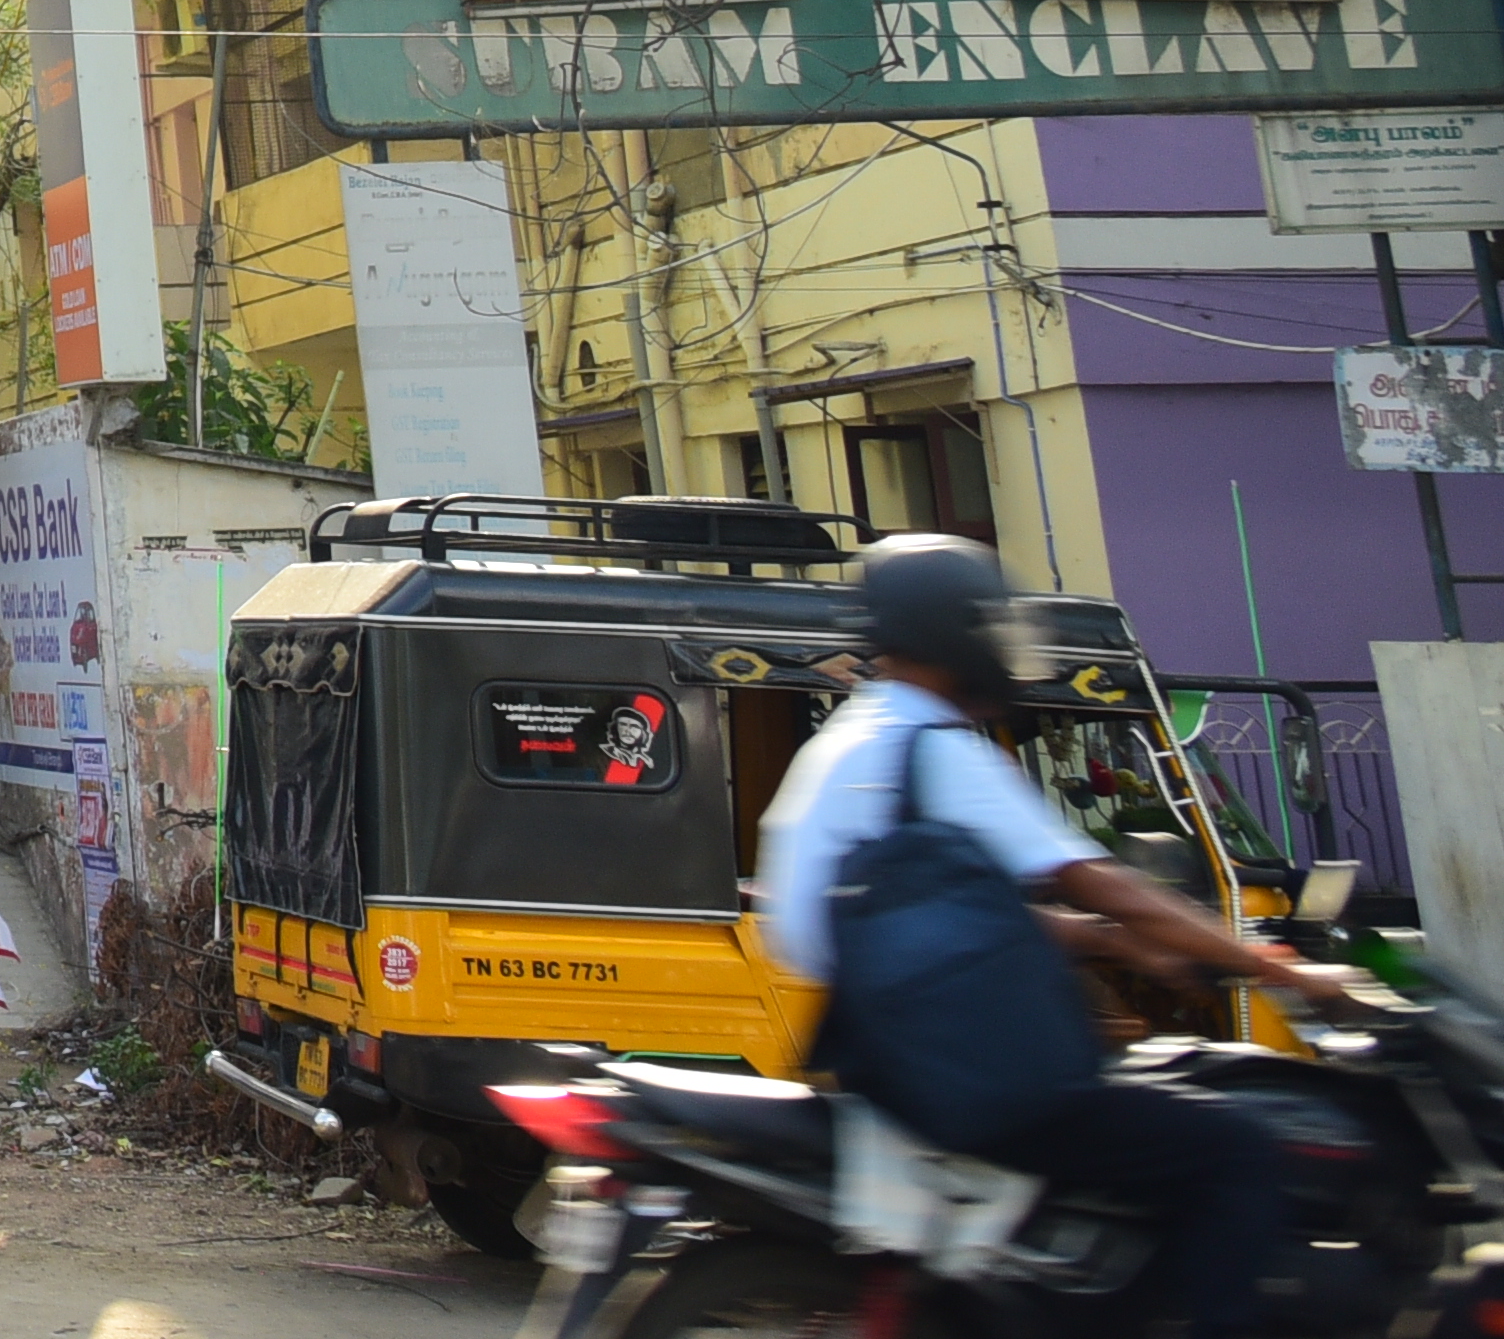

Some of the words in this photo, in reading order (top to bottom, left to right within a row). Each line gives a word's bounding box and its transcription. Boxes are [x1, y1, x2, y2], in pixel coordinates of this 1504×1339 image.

[32, 477, 83, 561] Bank
[462, 957, 492, 978] TN
[499, 957, 526, 979] 63
[532, 959, 563, 981] BC
[569, 961, 619, 984] 7731
